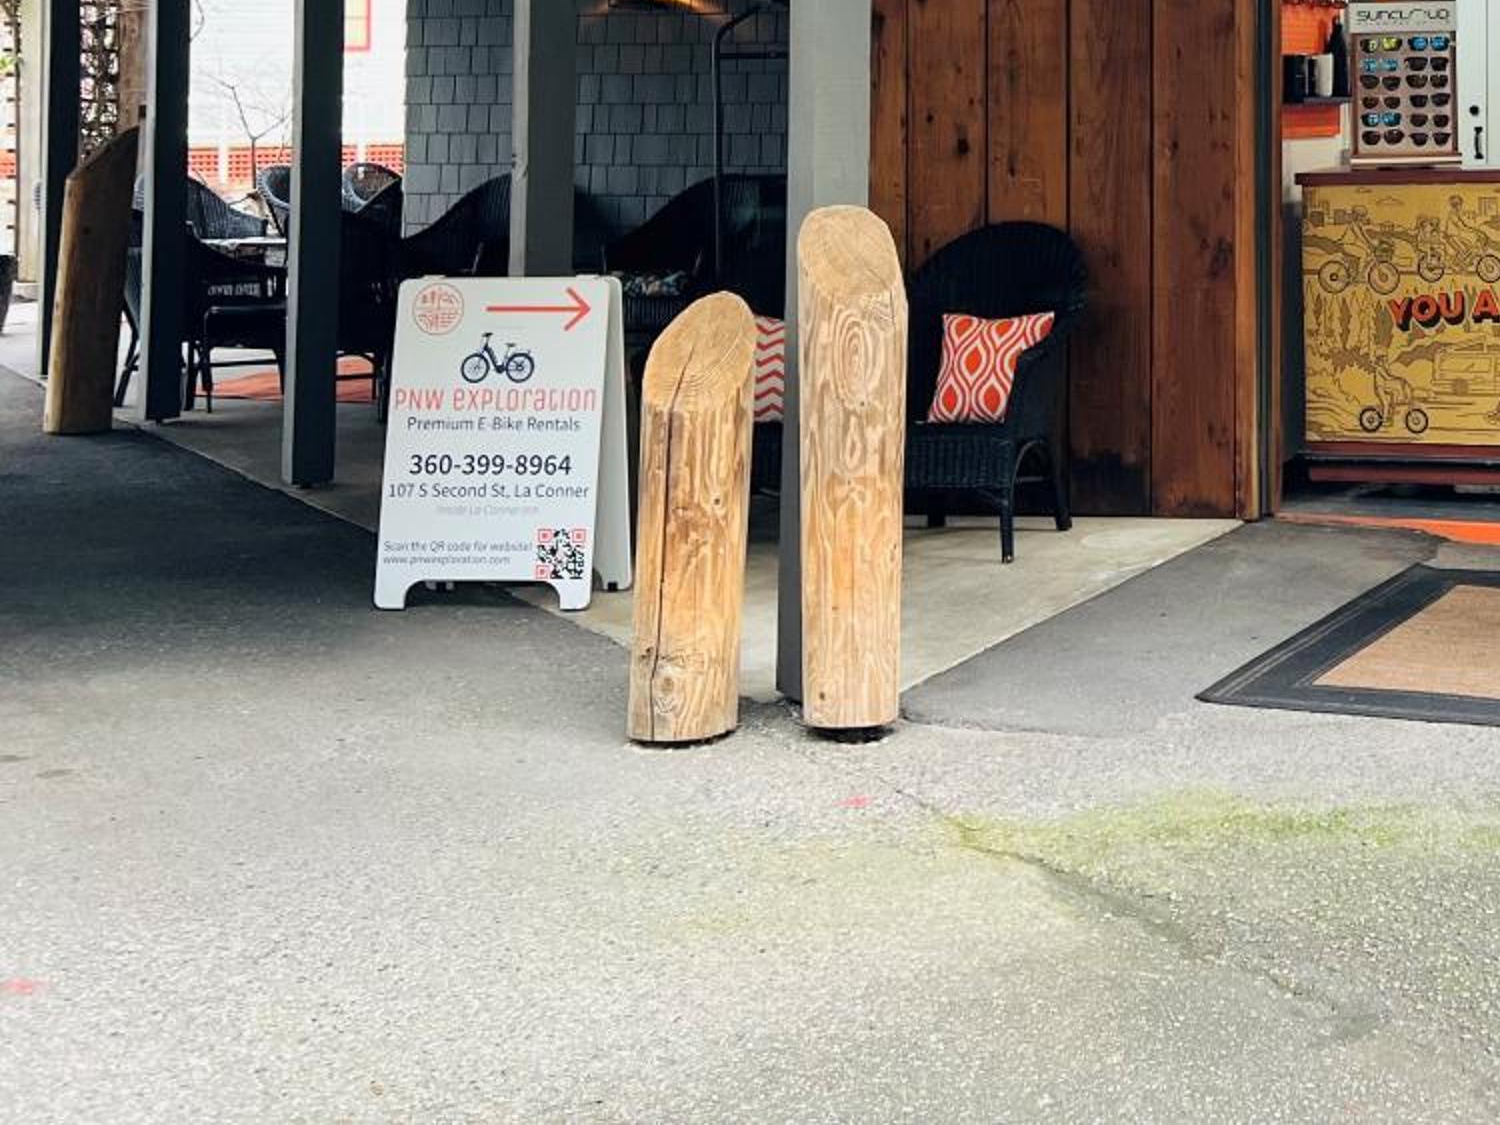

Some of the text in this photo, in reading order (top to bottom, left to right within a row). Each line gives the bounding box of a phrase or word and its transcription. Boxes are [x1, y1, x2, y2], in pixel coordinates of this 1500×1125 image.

[1387, 288, 1466, 332] YOU
[394, 388, 445, 411] PNW
[407, 416, 474, 431] Premium
[527, 416, 581, 431] Rentals
[408, 453, 573, 476] 360-399-8964
[388, 483, 589, 500] 107 S Second St, La Conner
